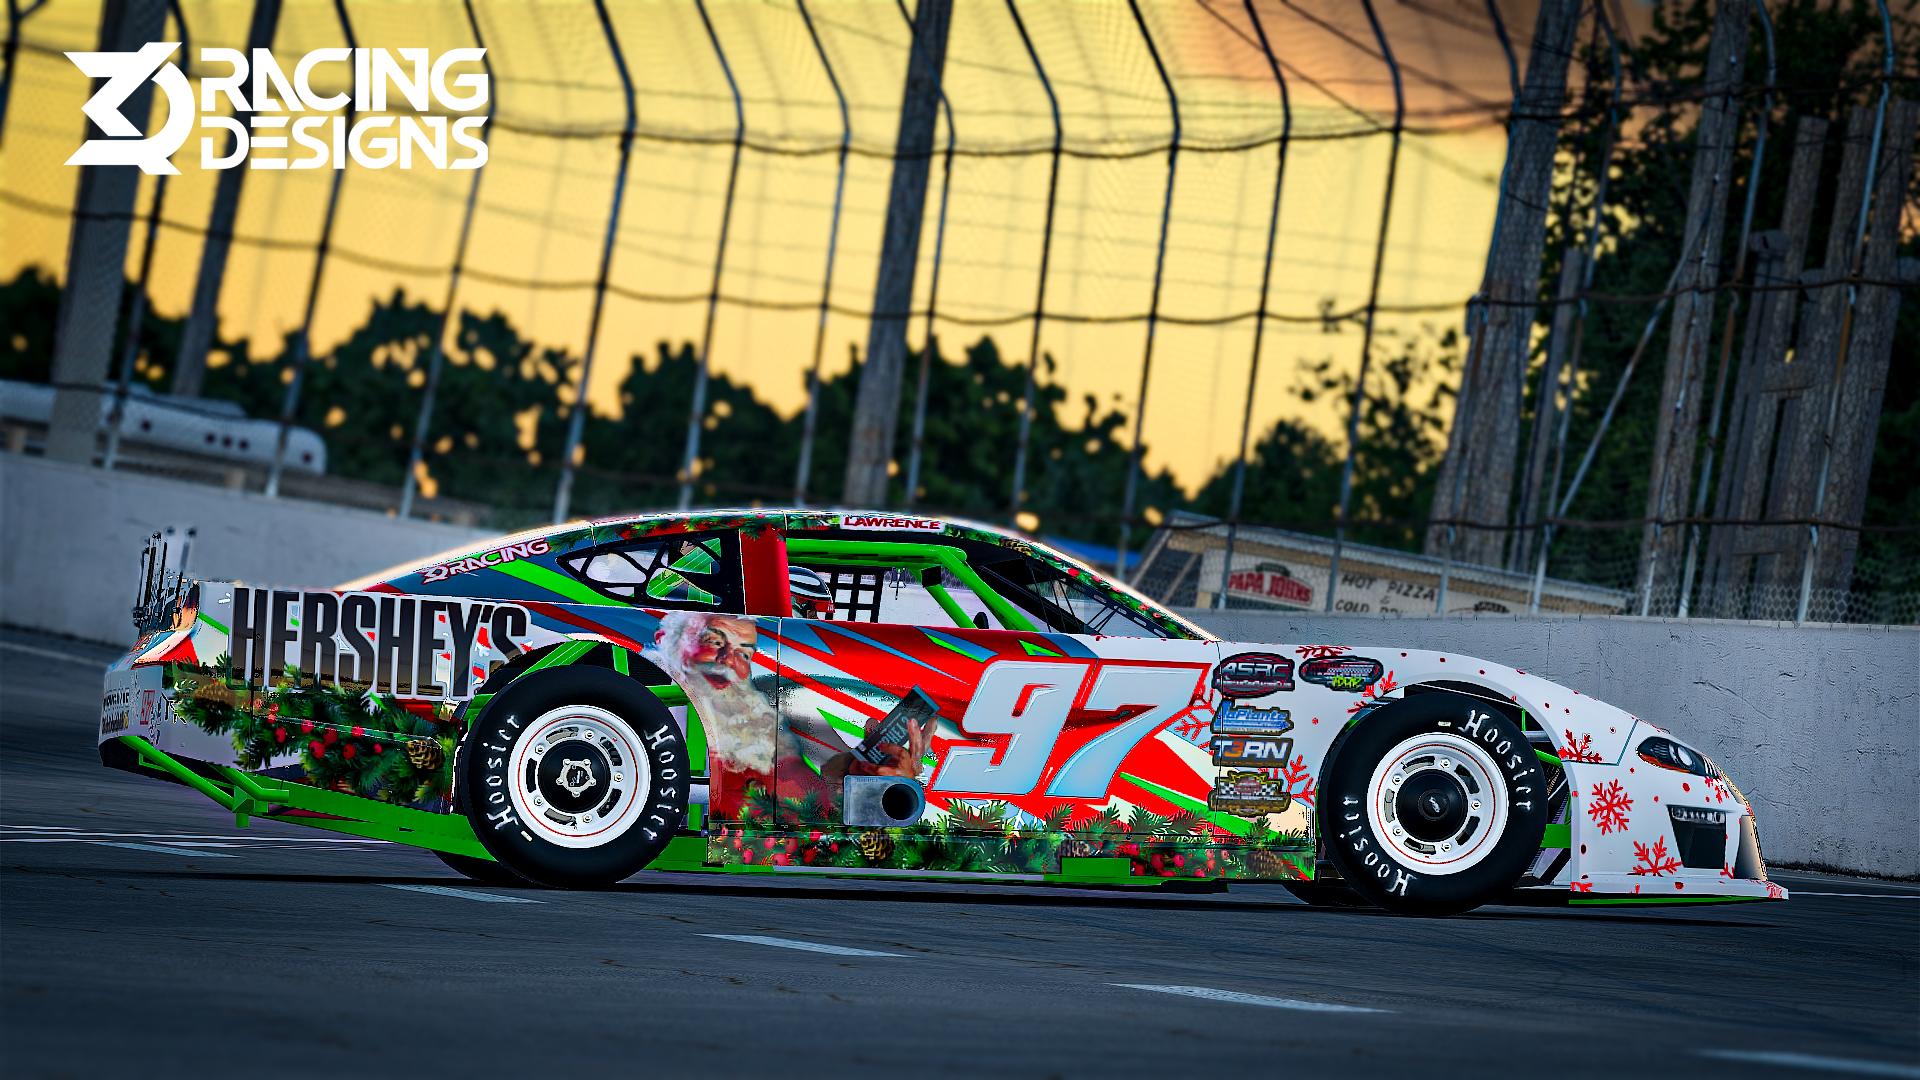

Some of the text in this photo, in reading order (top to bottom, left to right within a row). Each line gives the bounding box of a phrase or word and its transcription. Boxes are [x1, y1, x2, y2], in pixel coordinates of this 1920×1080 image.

[449, 538, 551, 576] RACING
[843, 516, 942, 530] LAWRENCE
[1227, 571, 1265, 594] PAPA
[1334, 599, 1370, 614] COLD
[1341, 573, 1435, 602] HOT PIZZA
[230, 588, 529, 699] HERSHEY'S
[1221, 662, 1290, 677] ASRC
[930, 659, 1206, 799] 97
[1458, 709, 1536, 812] Hoosier
[482, 714, 522, 831] Hoosier
[642, 723, 681, 842] Hoosier
[1340, 795, 1418, 897] Hoosier
